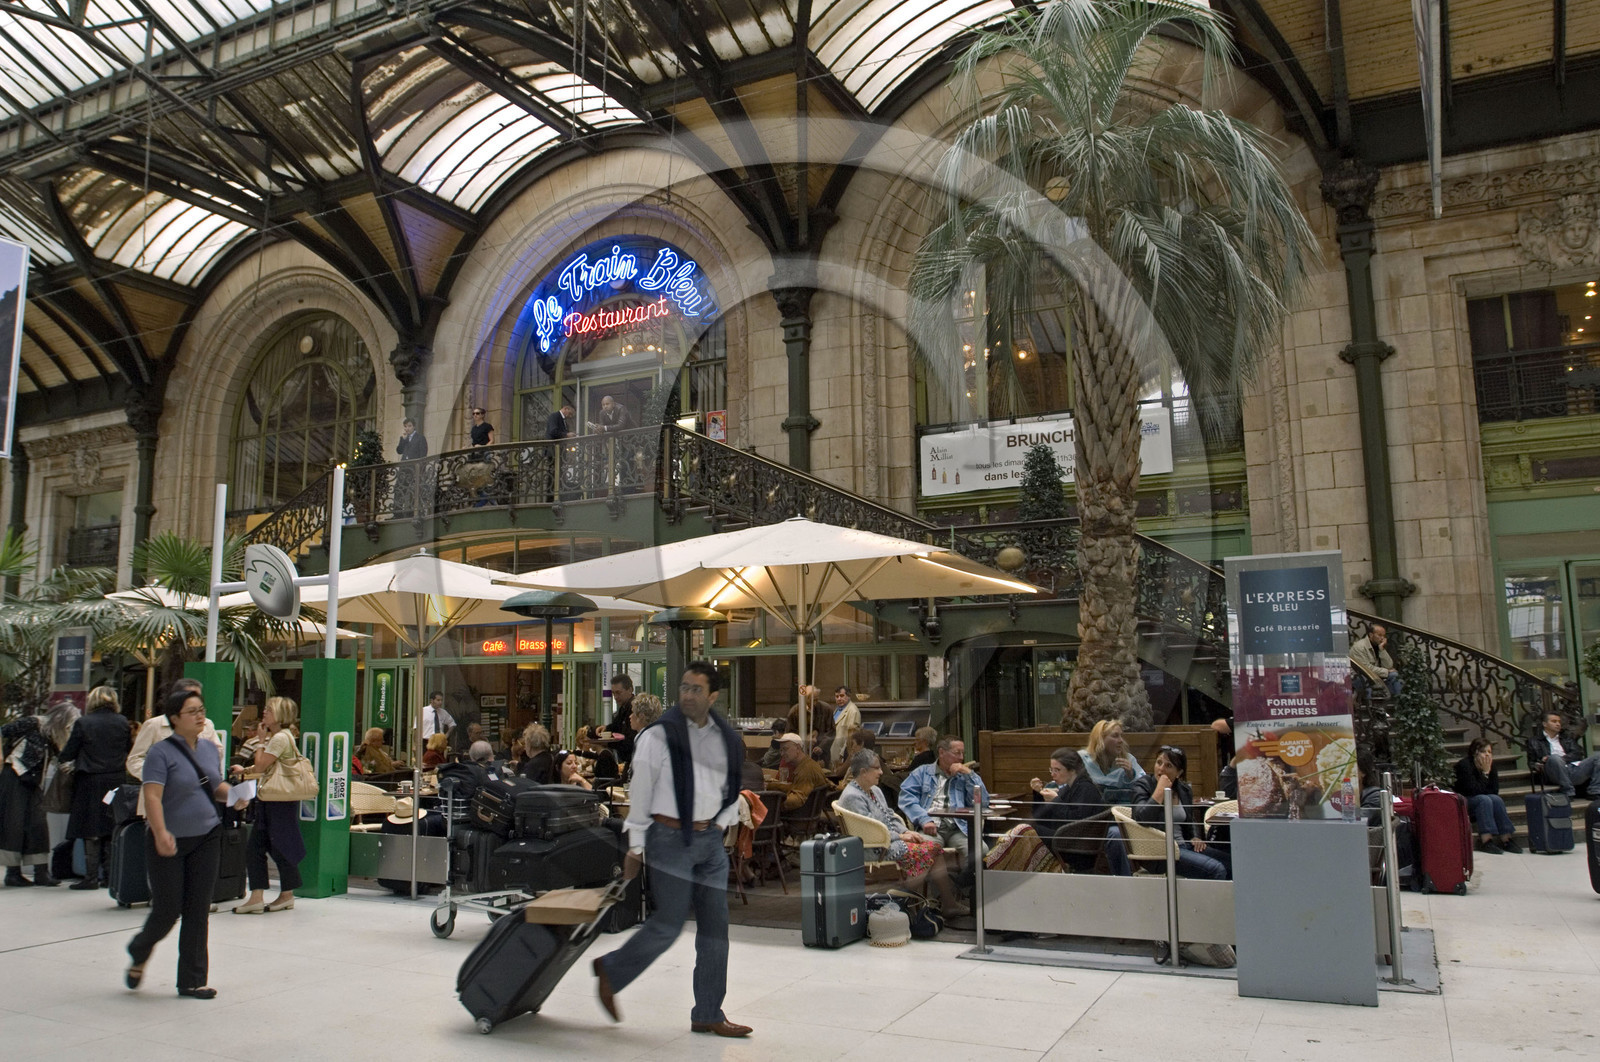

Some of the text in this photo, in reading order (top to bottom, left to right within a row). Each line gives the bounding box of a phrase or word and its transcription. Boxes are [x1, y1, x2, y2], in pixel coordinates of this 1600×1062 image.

[533, 244, 702, 353] Le Train Bleu
[562, 294, 669, 338] Restaurant
[1006, 429, 1074, 448] BRUNCH
[984, 472, 1008, 481] dans
[1011, 470, 1025, 479] les
[1246, 589, 1325, 604] L'EXPRESS
[1272, 603, 1299, 612] BLEU
[1254, 623, 1320, 633] Café Brasserie
[482, 638, 562, 652] Café Brassie
[1266, 698, 1317, 707] FORMULE
[1270, 707, 1318, 716] EXPRESS
[1280, 745, 1304, 757] -30
